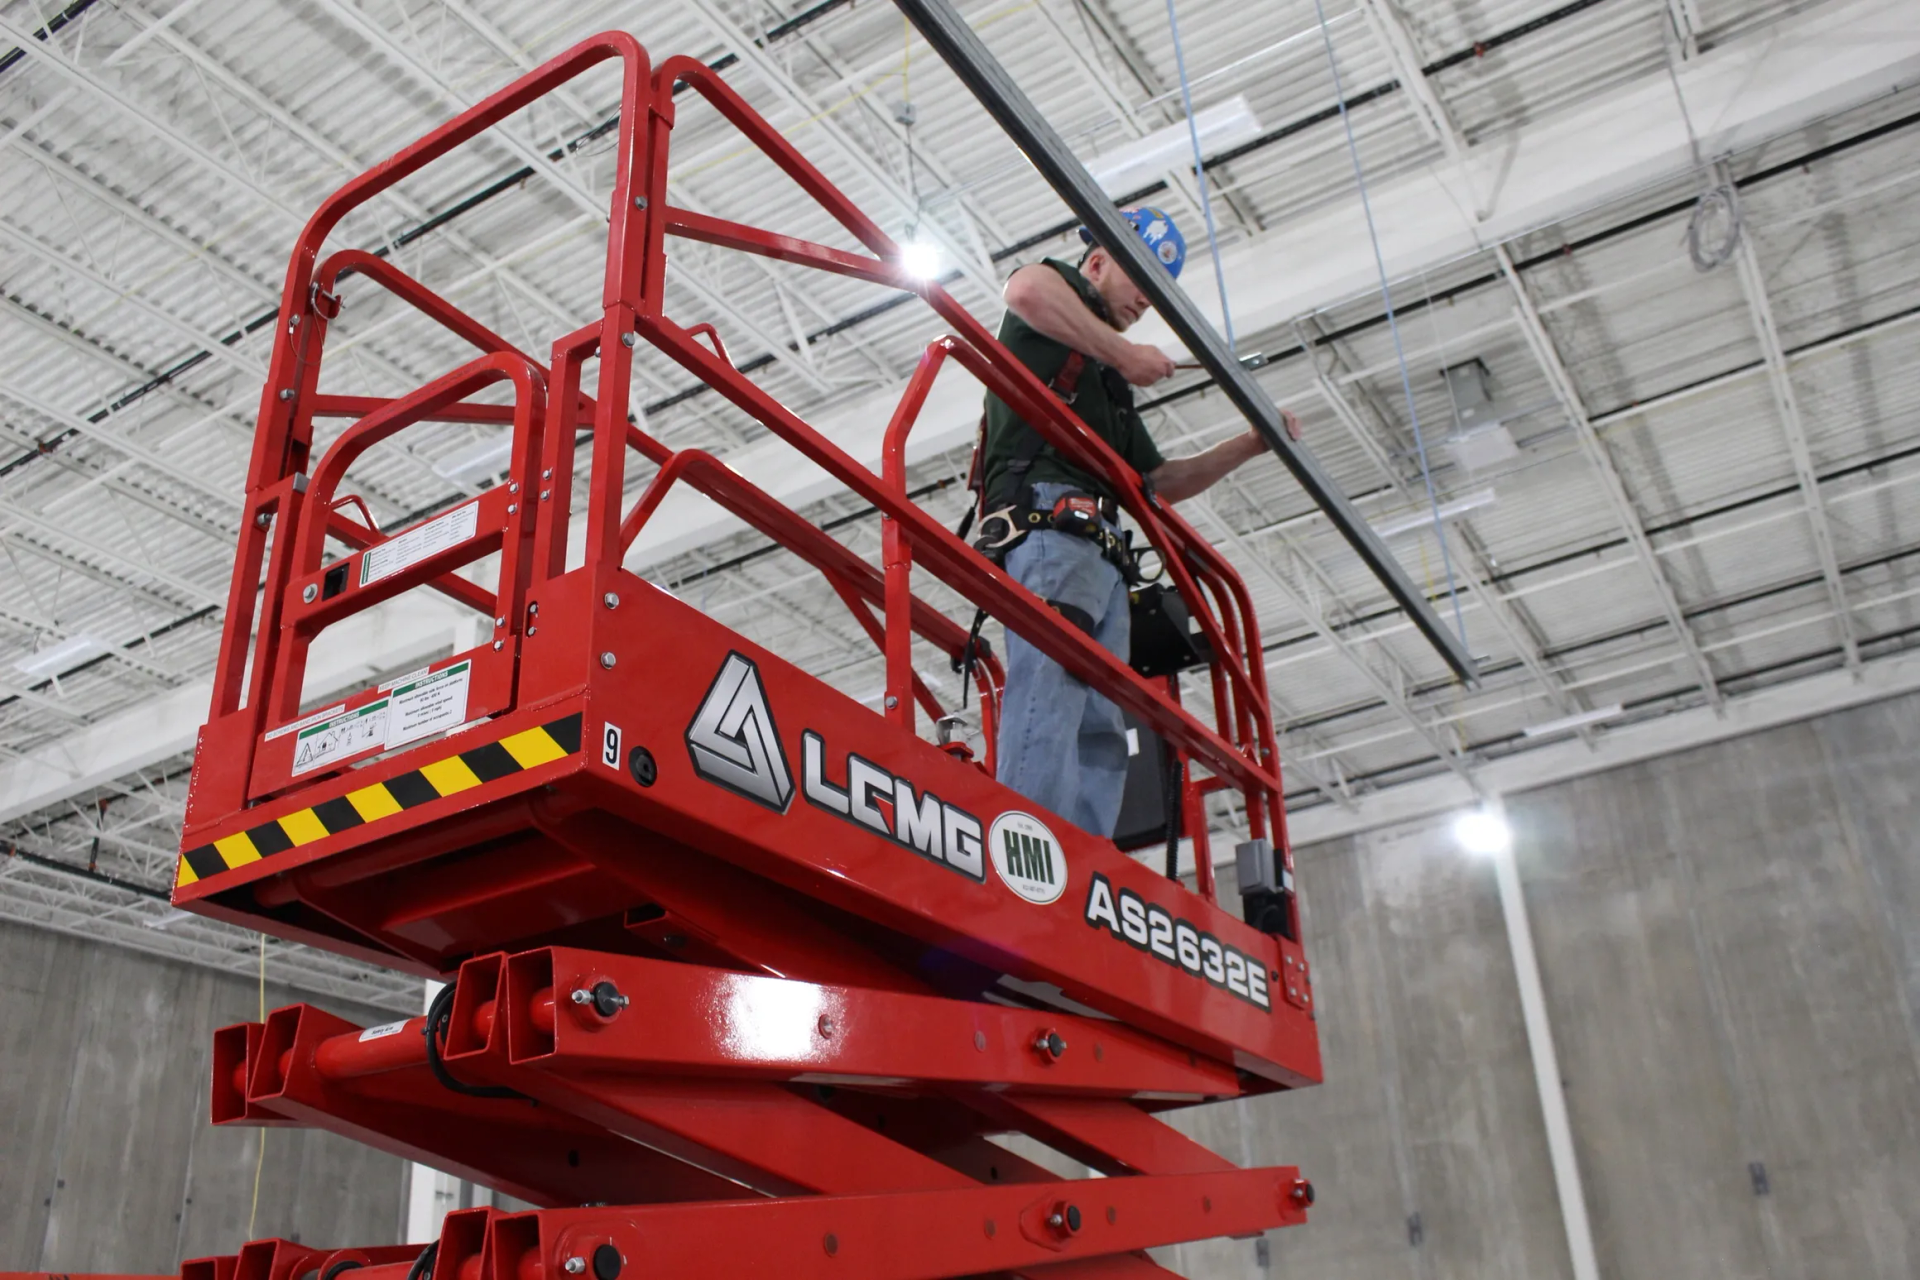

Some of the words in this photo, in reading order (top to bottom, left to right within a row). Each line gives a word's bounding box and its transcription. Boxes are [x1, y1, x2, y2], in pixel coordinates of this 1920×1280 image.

[412, 668, 428, 679] CLEAN
[415, 670, 448, 688] INSTRUCTIONS
[328, 711, 360, 728] INSTRUCTIONS
[605, 728, 619, 765] 9
[1003, 828, 1055, 886] HMI
[1087, 876, 1270, 1010] AS2632E
